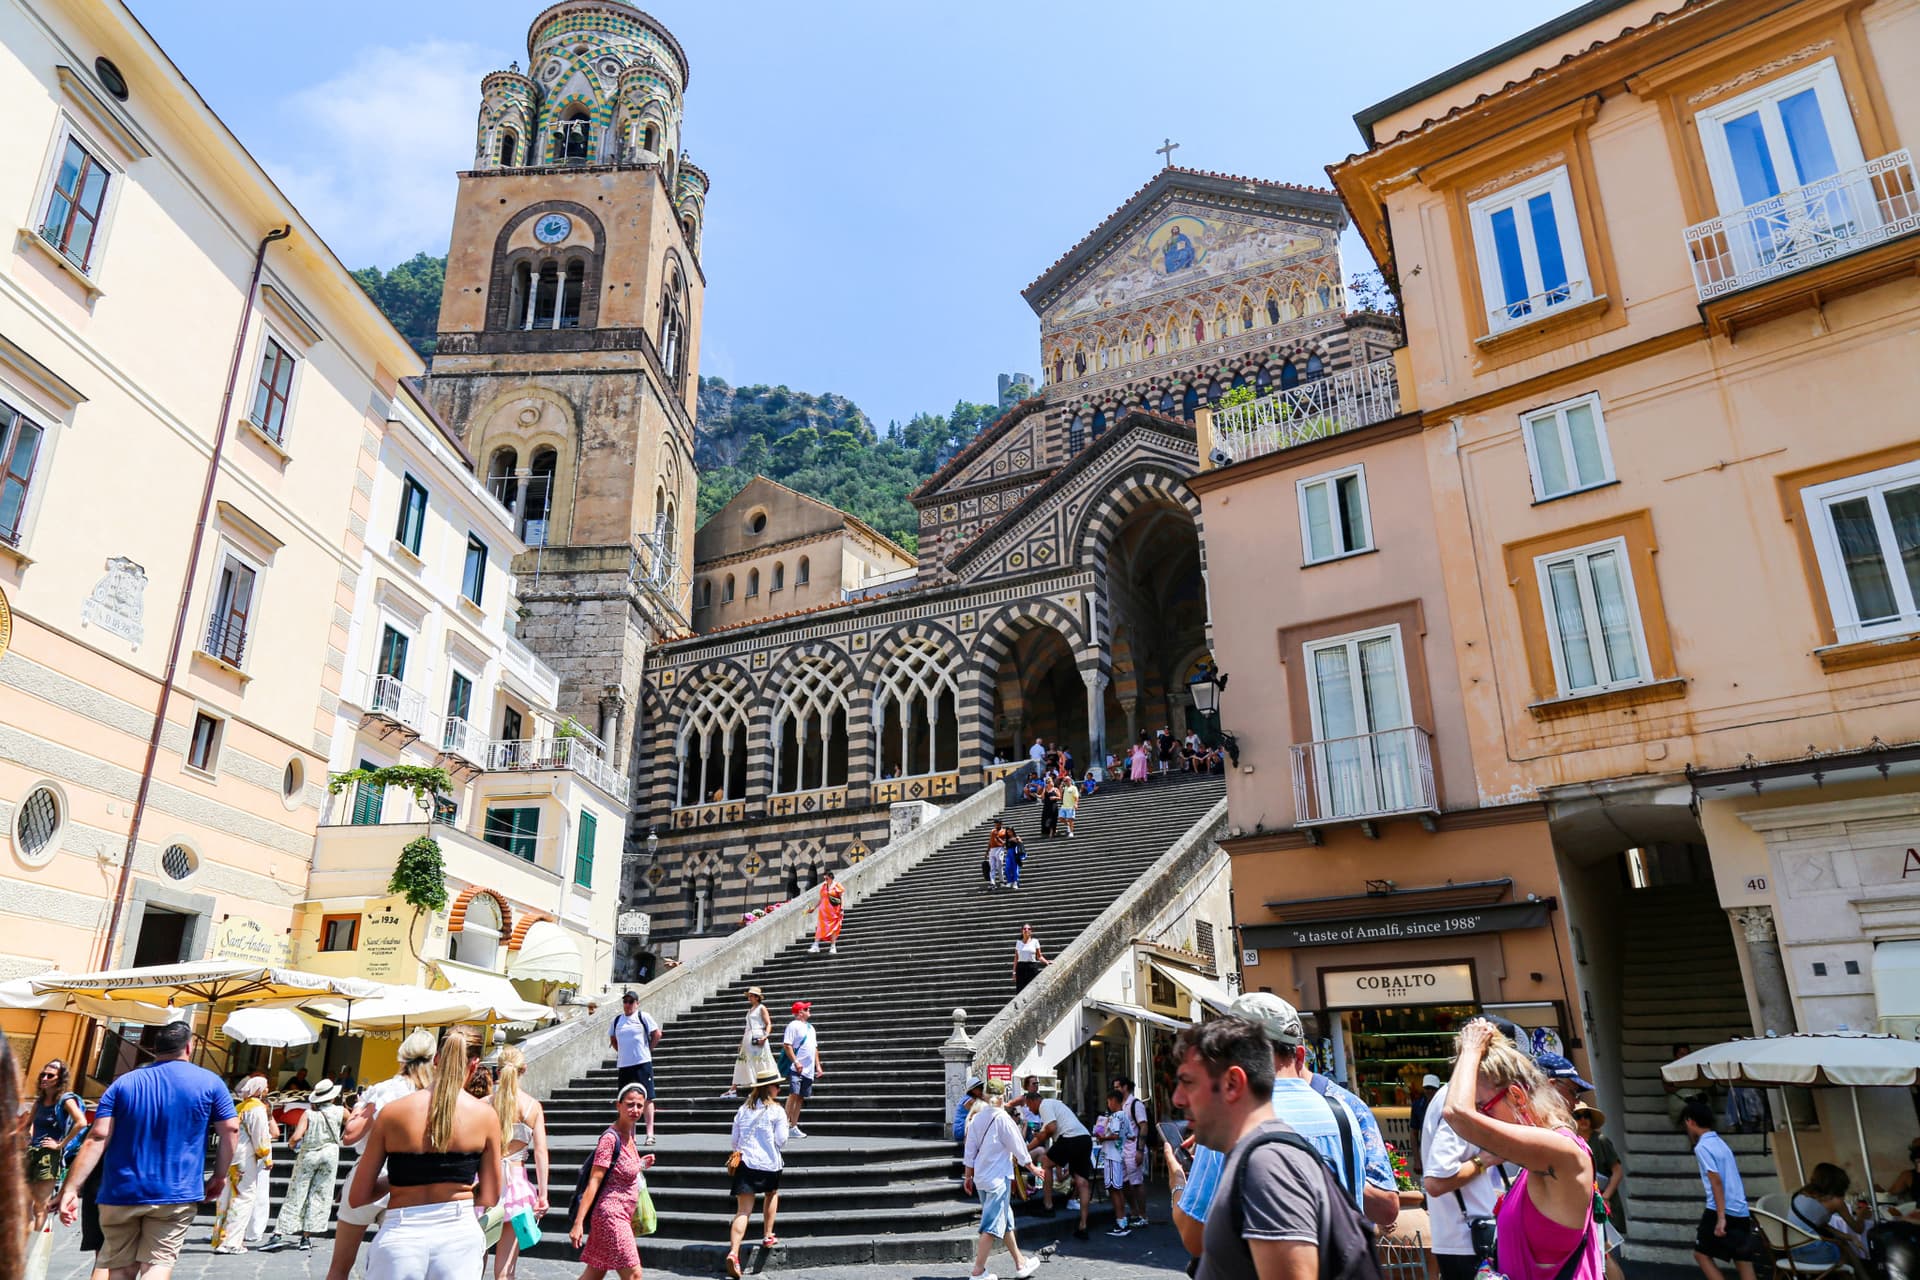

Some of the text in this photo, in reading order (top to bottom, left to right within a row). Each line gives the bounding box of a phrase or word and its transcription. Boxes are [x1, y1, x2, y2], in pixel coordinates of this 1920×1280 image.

[1747, 878, 1766, 890] 40
[1308, 930, 1338, 942] taste
[1341, 927, 1354, 940] of
[1356, 923, 1404, 939] Amalfi,
[1406, 922, 1441, 934] since
[1245, 952, 1257, 962] 39
[152, 975, 187, 985] WINE
[1356, 973, 1436, 990] COBALTO
